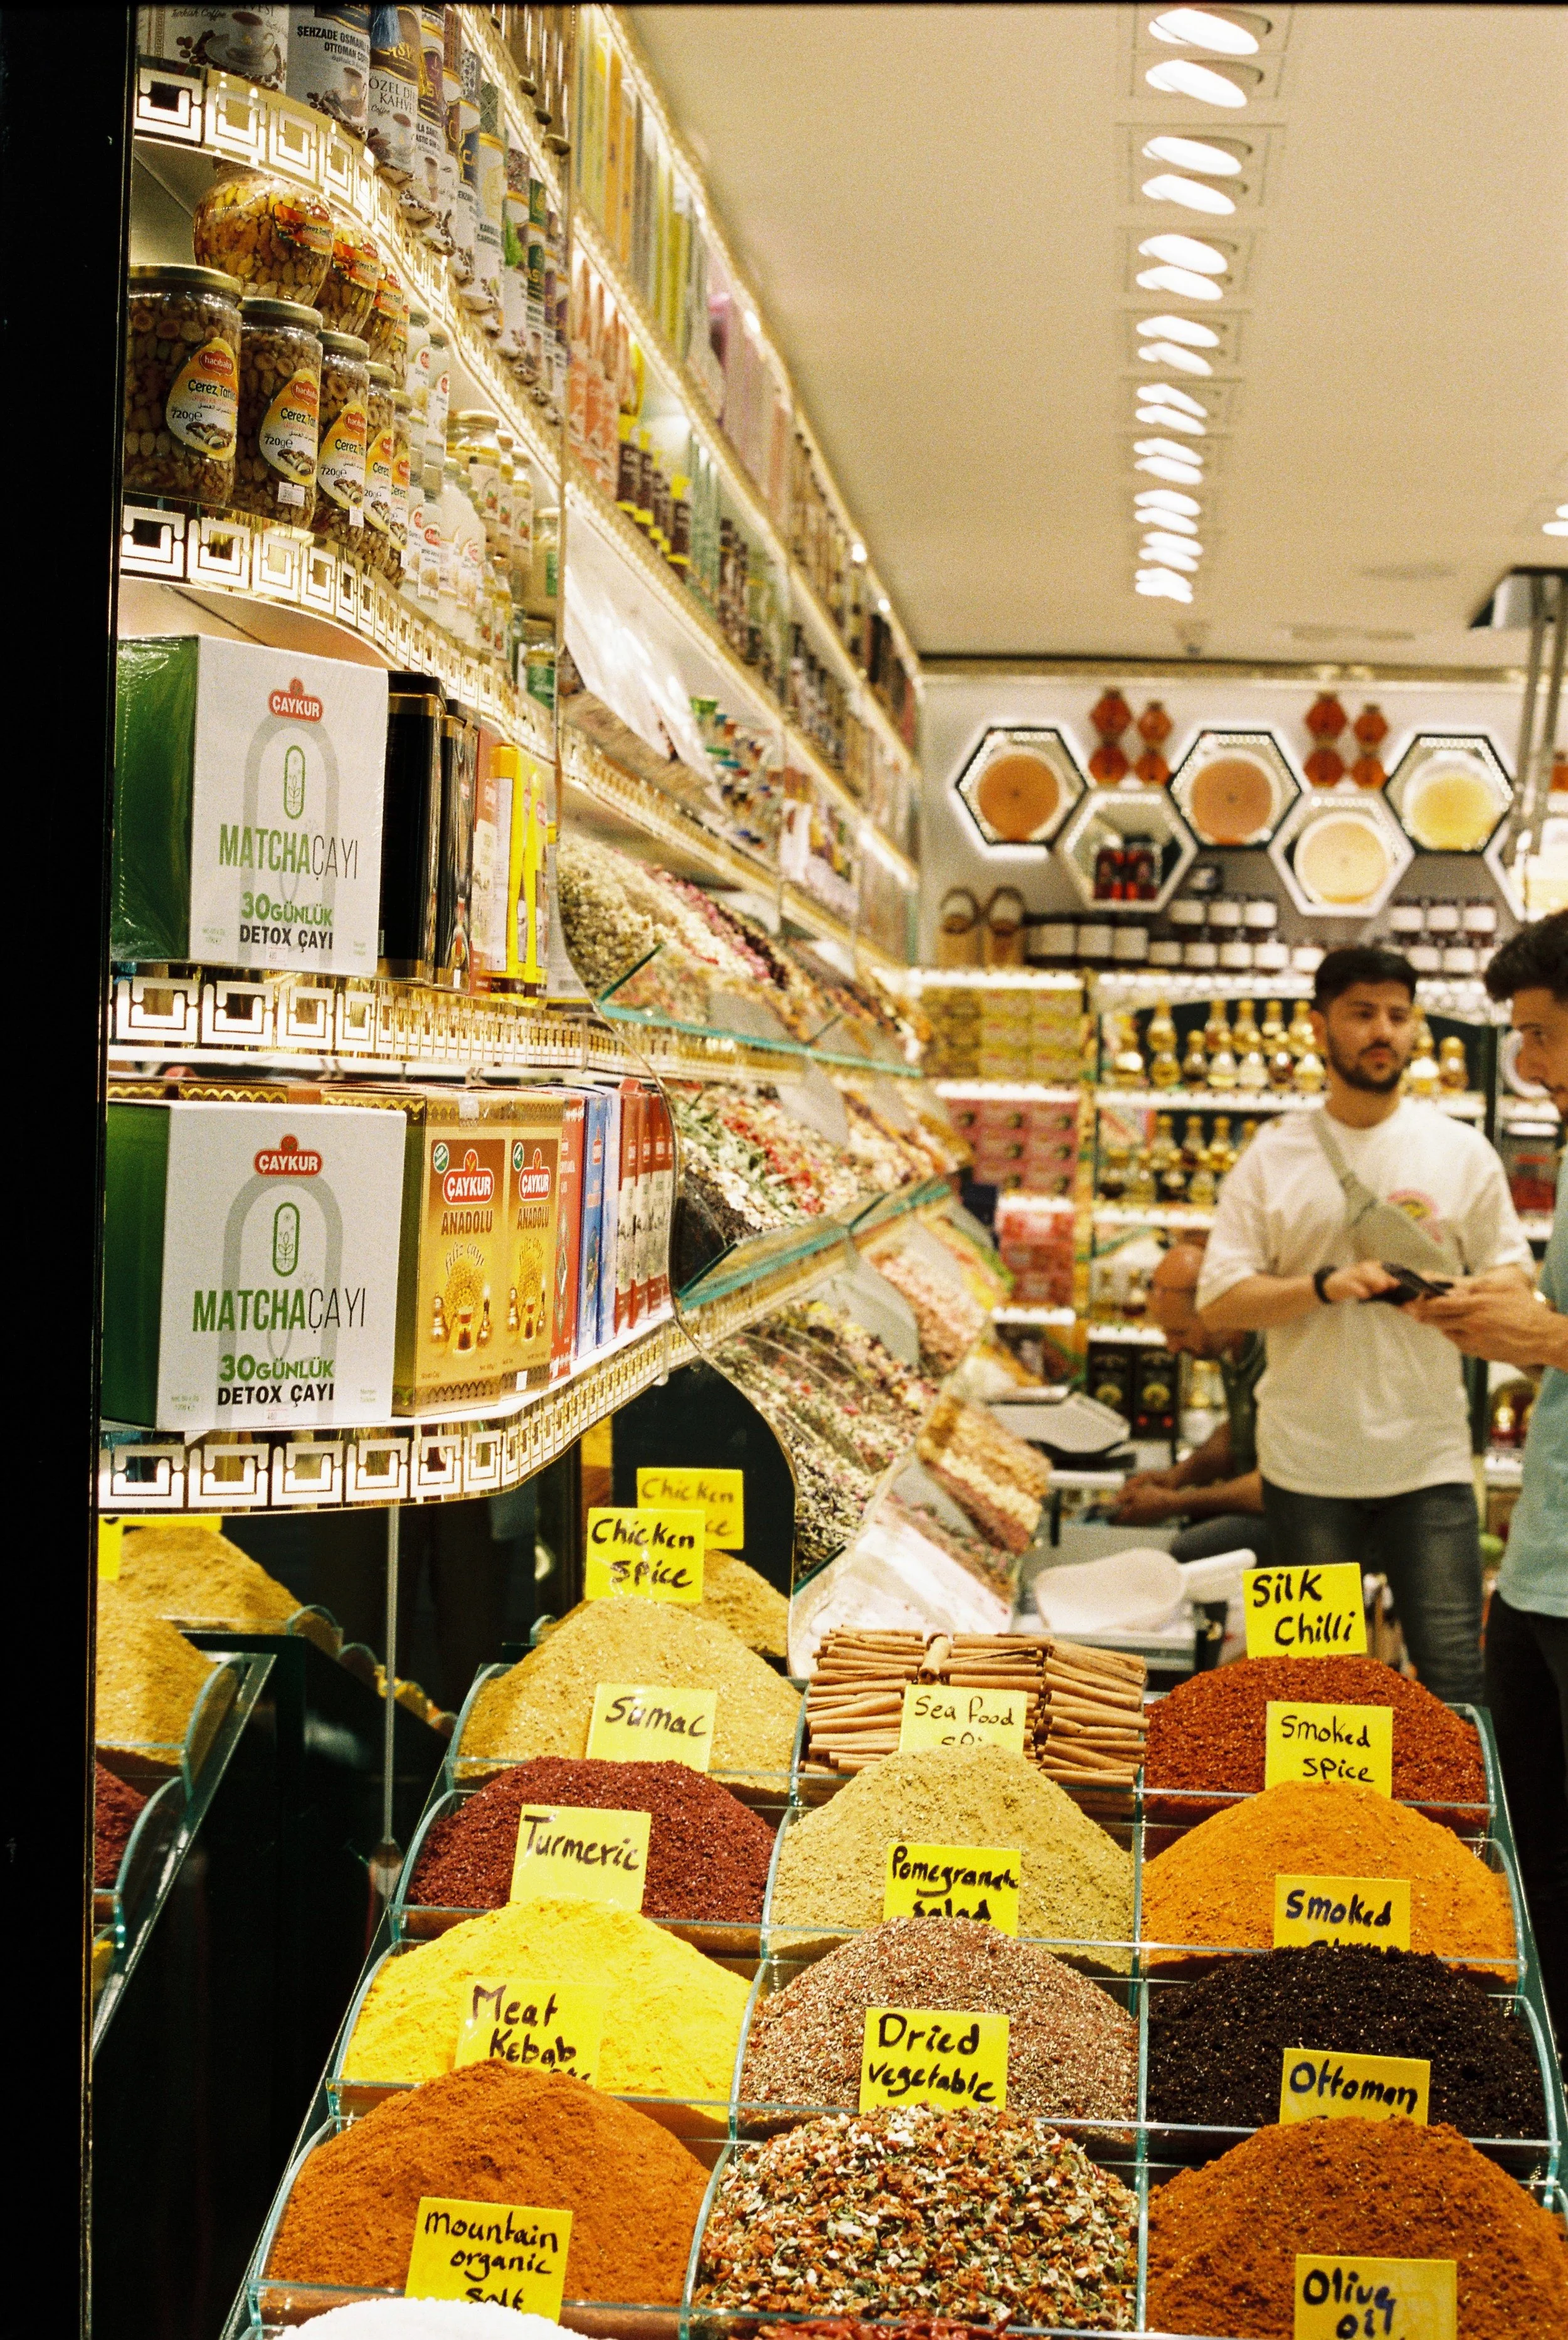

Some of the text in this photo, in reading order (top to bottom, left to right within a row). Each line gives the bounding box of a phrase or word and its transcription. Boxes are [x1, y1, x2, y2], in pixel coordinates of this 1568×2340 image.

[297, 25, 338, 41] ŞEHZADE
[324, 41, 356, 58] OTTOMAN
[369, 75, 400, 95] ÖZEL
[188, 379, 218, 397] Çerez
[280, 407, 307, 426] Çerez
[335, 438, 358, 454] Çerez
[272, 694, 320, 718] ÇAYKUR
[240, 923, 292, 947] DETOX
[298, 930, 333, 953] ÇAYI
[258, 1153, 319, 1172] ÇAYKUR
[447, 1176, 492, 1202] ÇAYKUR
[521, 1175, 549, 1198] ÇAYKUR
[440, 1209, 493, 1236] ANADOLU
[516, 1206, 549, 1230] ANADOLU
[217, 1385, 283, 1406] DETOX
[290, 1383, 334, 1408] ÇAYI
[642, 1477, 734, 1504] Chicken
[591, 1518, 695, 1550] Chicken
[1253, 1569, 1323, 1607] Silk
[1274, 1611, 1356, 1646] Chilli
[605, 1696, 707, 1737] Sumac
[915, 1695, 956, 1721] Sea
[1281, 1715, 1370, 1748] Smoked
[522, 1814, 639, 1871] Turmeric
[1286, 1890, 1392, 1928] Smoked
[472, 1984, 558, 2027] Meat
[489, 2027, 577, 2065] Kebab
[878, 2013, 980, 2055] Dried
[1289, 2058, 1419, 2114] Ottoman
[450, 2249, 552, 2282] organic
[1303, 2267, 1396, 2309] Olive
